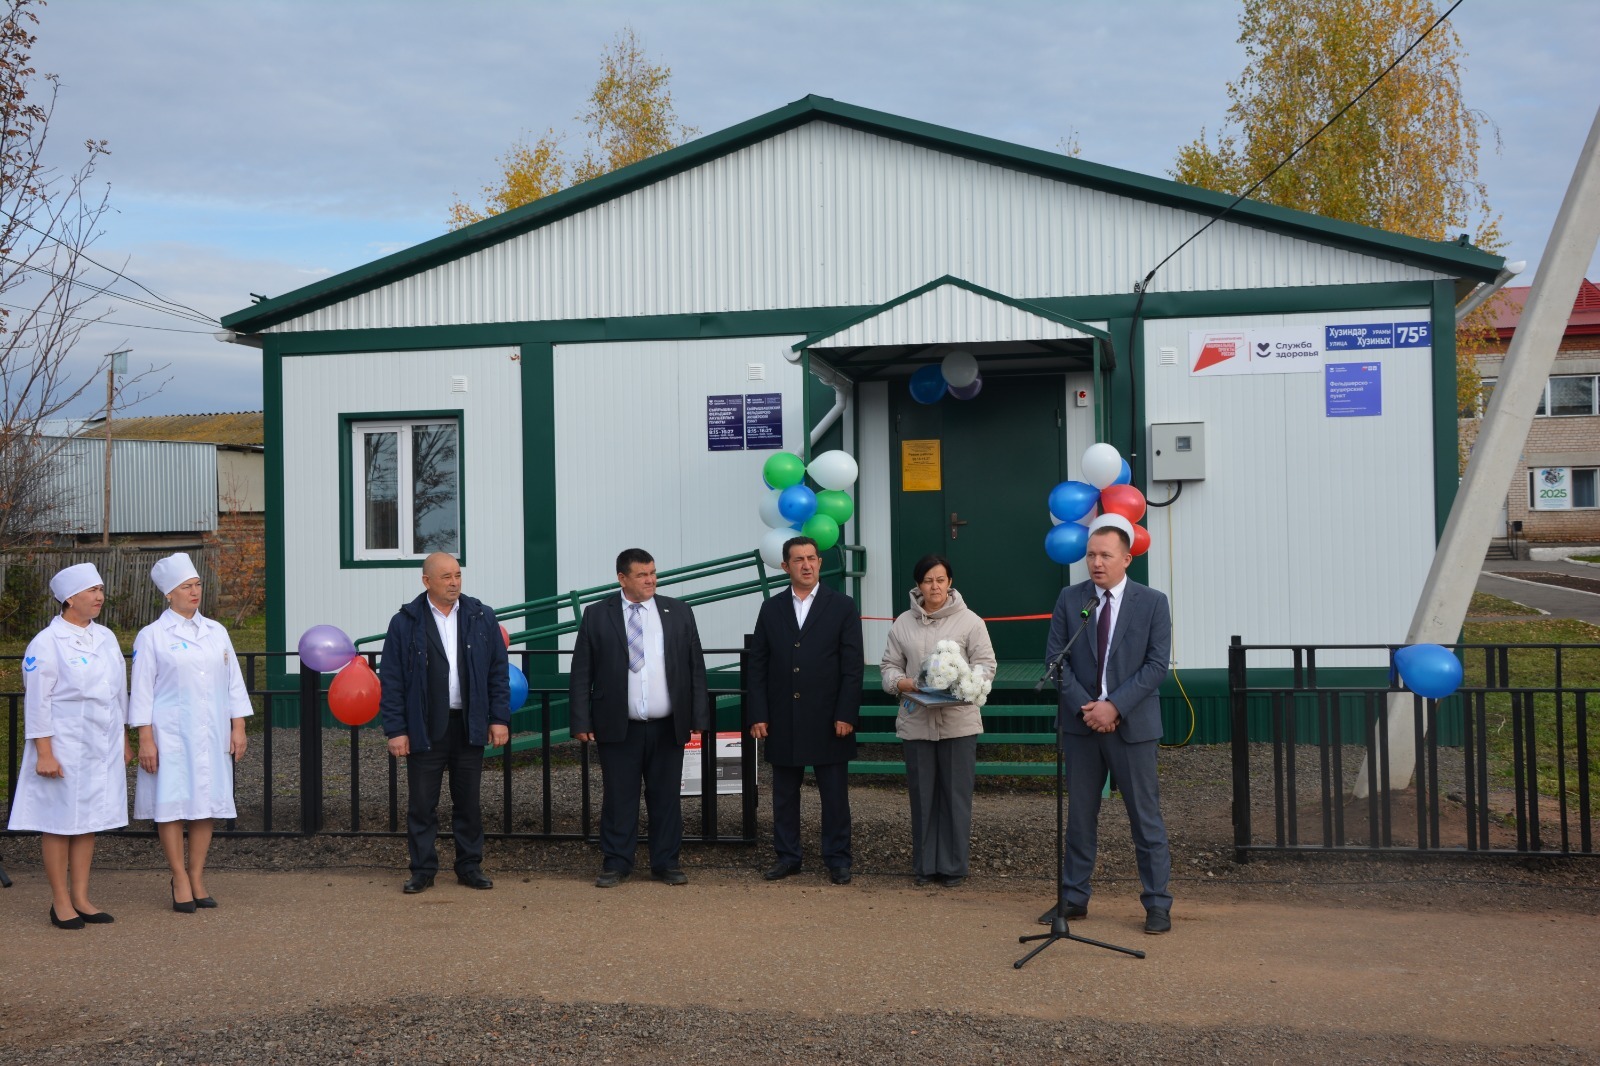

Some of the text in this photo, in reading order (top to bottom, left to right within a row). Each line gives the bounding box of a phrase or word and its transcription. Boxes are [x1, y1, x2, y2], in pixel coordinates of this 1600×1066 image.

[1329, 327, 1367, 338] Хузиндар
[1275, 341, 1312, 351] Служба
[1357, 336, 1391, 347] Хузиных
[1275, 350, 1319, 358] здоровья
[1540, 488, 1567, 498] 2025
